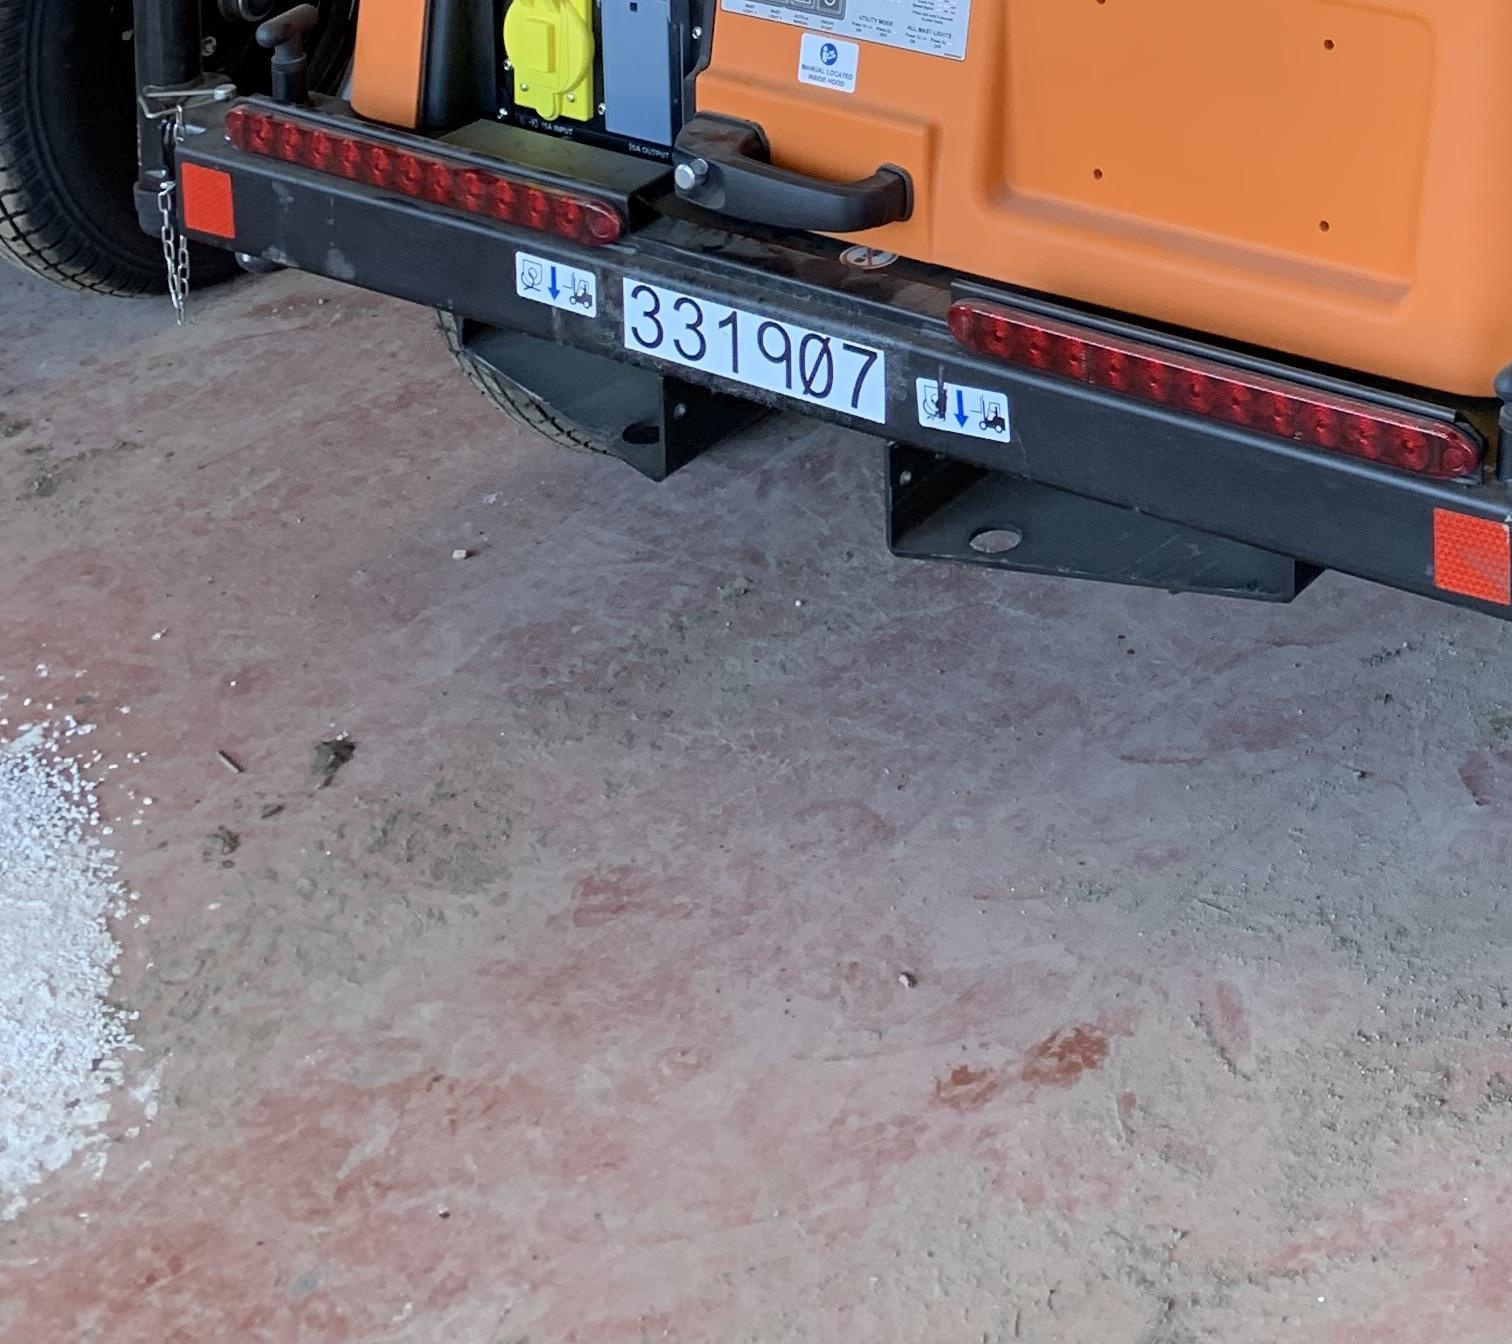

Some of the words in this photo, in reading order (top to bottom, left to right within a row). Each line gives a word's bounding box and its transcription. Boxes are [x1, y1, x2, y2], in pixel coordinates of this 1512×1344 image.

[801, 63, 826, 75] MANUAL
[826, 69, 854, 81] LOCATED
[642, 145, 670, 160] OUTPUT
[631, 284, 878, 409] 331907
